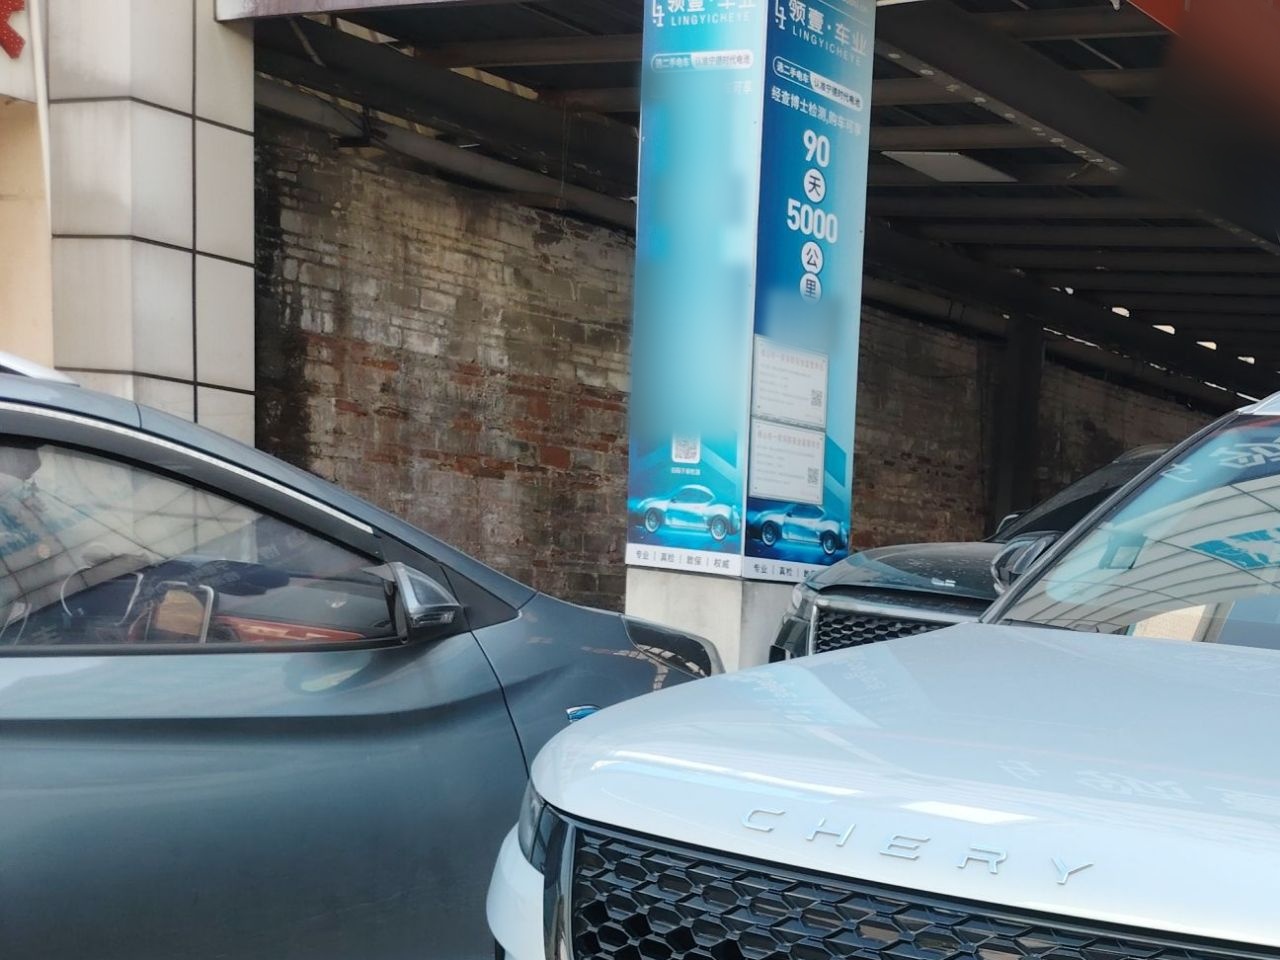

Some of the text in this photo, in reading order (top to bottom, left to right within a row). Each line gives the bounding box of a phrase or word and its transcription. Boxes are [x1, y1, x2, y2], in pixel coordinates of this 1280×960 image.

[803, 129, 830, 168] 90
[807, 176, 822, 198] 天
[787, 198, 838, 244] 5000
[741, 808, 1094, 886] CHERY
